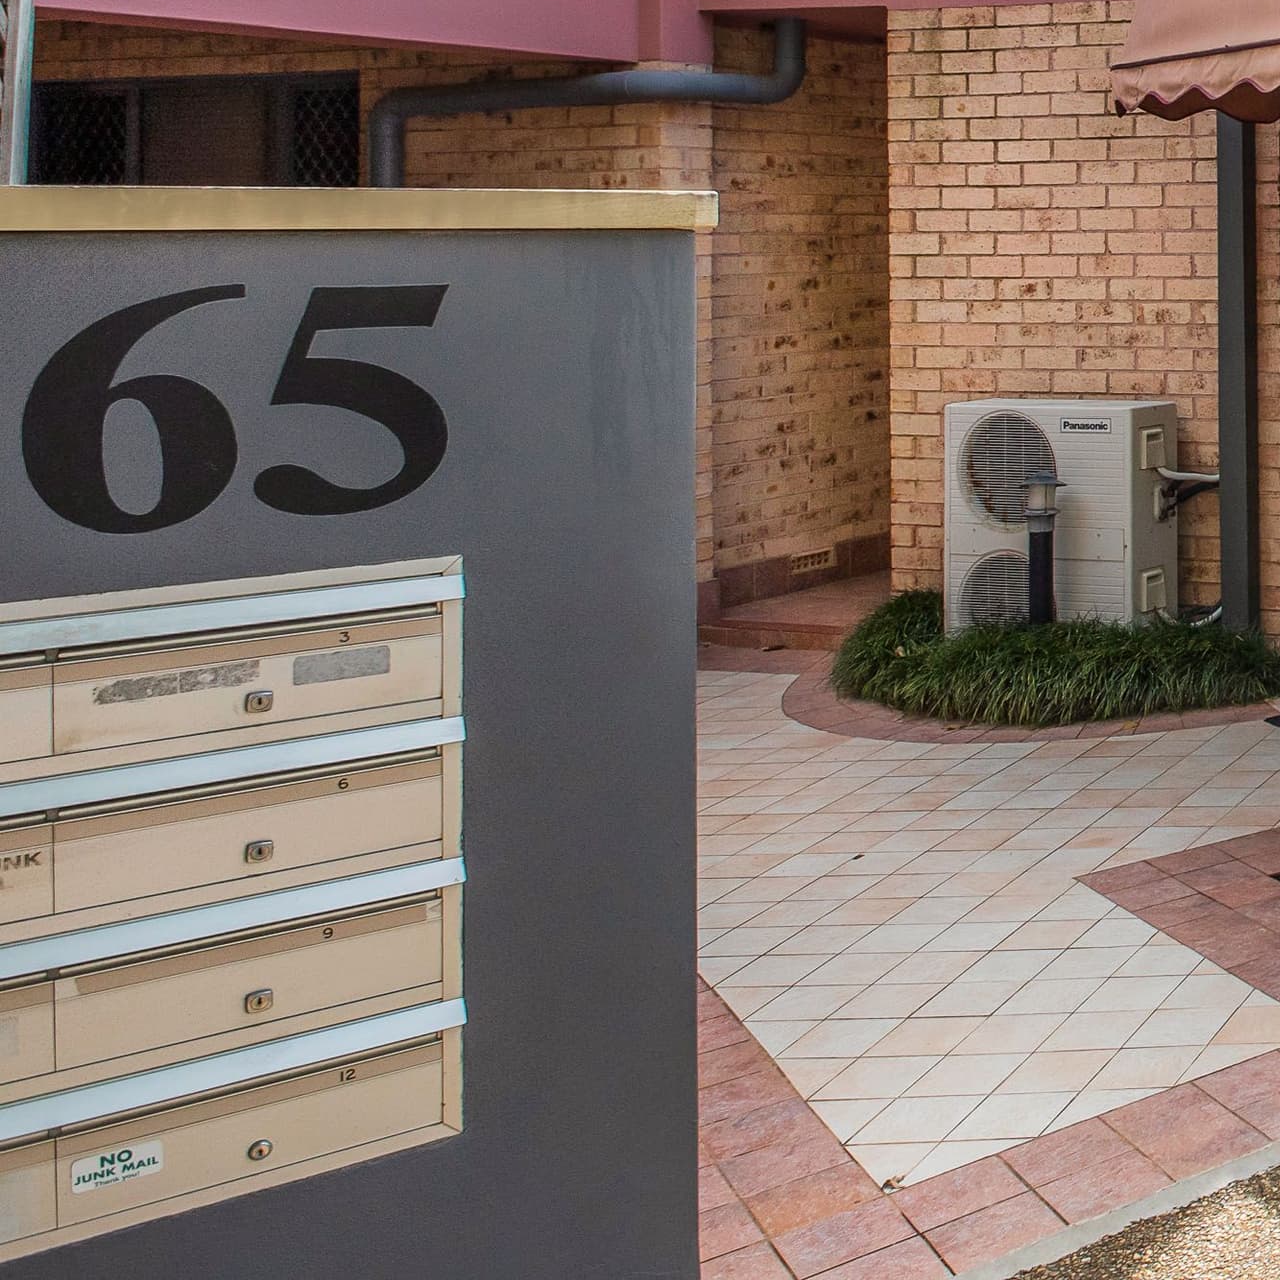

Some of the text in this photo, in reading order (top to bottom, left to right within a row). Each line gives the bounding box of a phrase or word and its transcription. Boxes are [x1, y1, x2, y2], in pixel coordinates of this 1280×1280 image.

[21, 283, 450, 534] 65
[1063, 420, 1108, 430] Panasonic
[339, 631, 350, 642] 3
[337, 778, 349, 789] 6
[0, 851, 42, 872] NK
[322, 927, 334, 939] 9
[339, 1068, 356, 1082] 12
[100, 1149, 132, 1168] NO
[74, 1156, 159, 1186] JUNK MAIL
[94, 1176, 119, 1187] Thank
